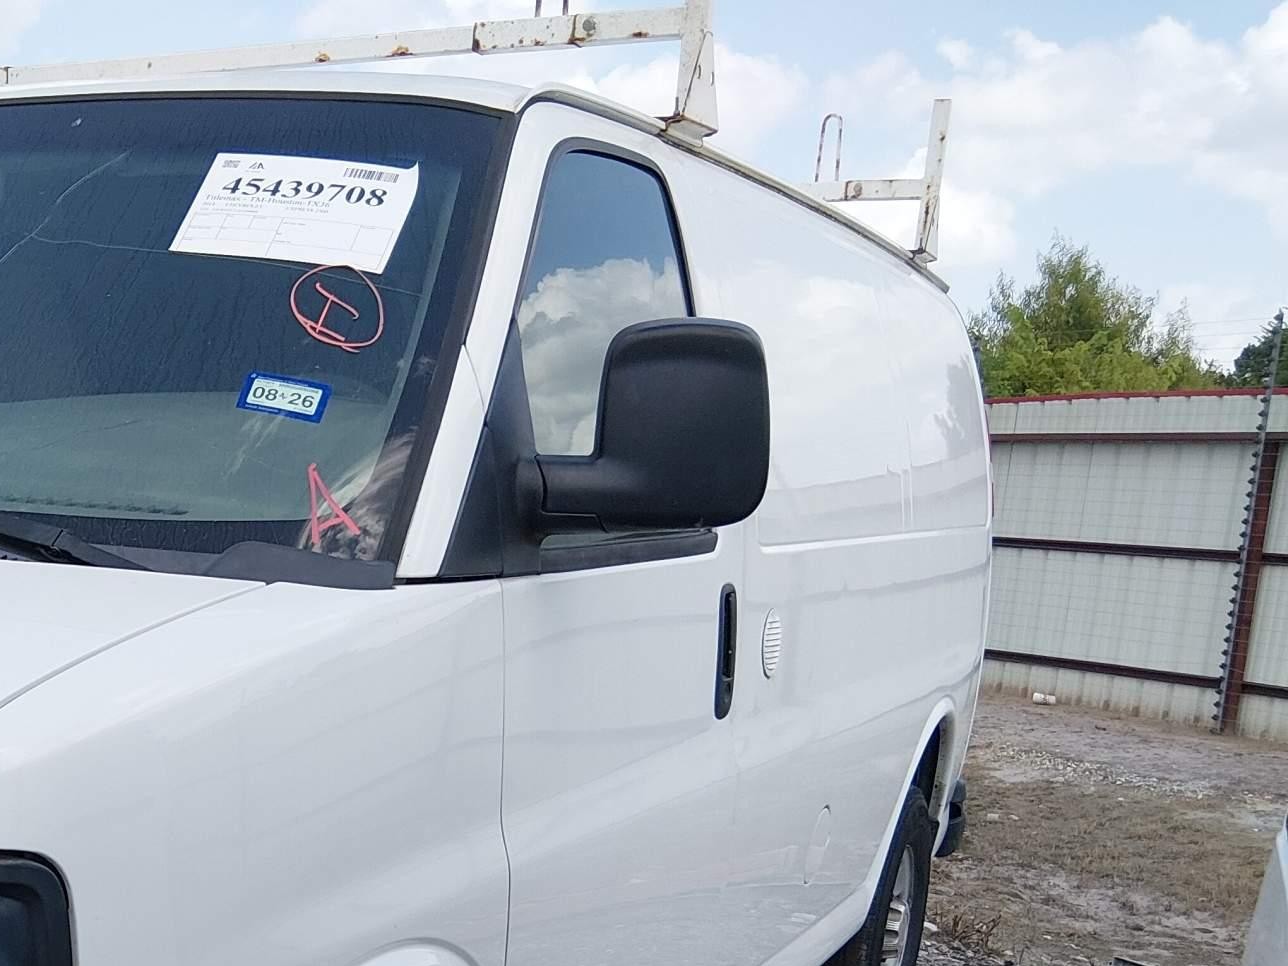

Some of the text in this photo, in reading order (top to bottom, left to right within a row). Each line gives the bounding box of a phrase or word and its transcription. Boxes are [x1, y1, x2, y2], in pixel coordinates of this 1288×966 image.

[222, 177, 387, 207] 45439708
[253, 386, 279, 401] 08
[288, 393, 315, 408] 26
[306, 462, 361, 546] A
